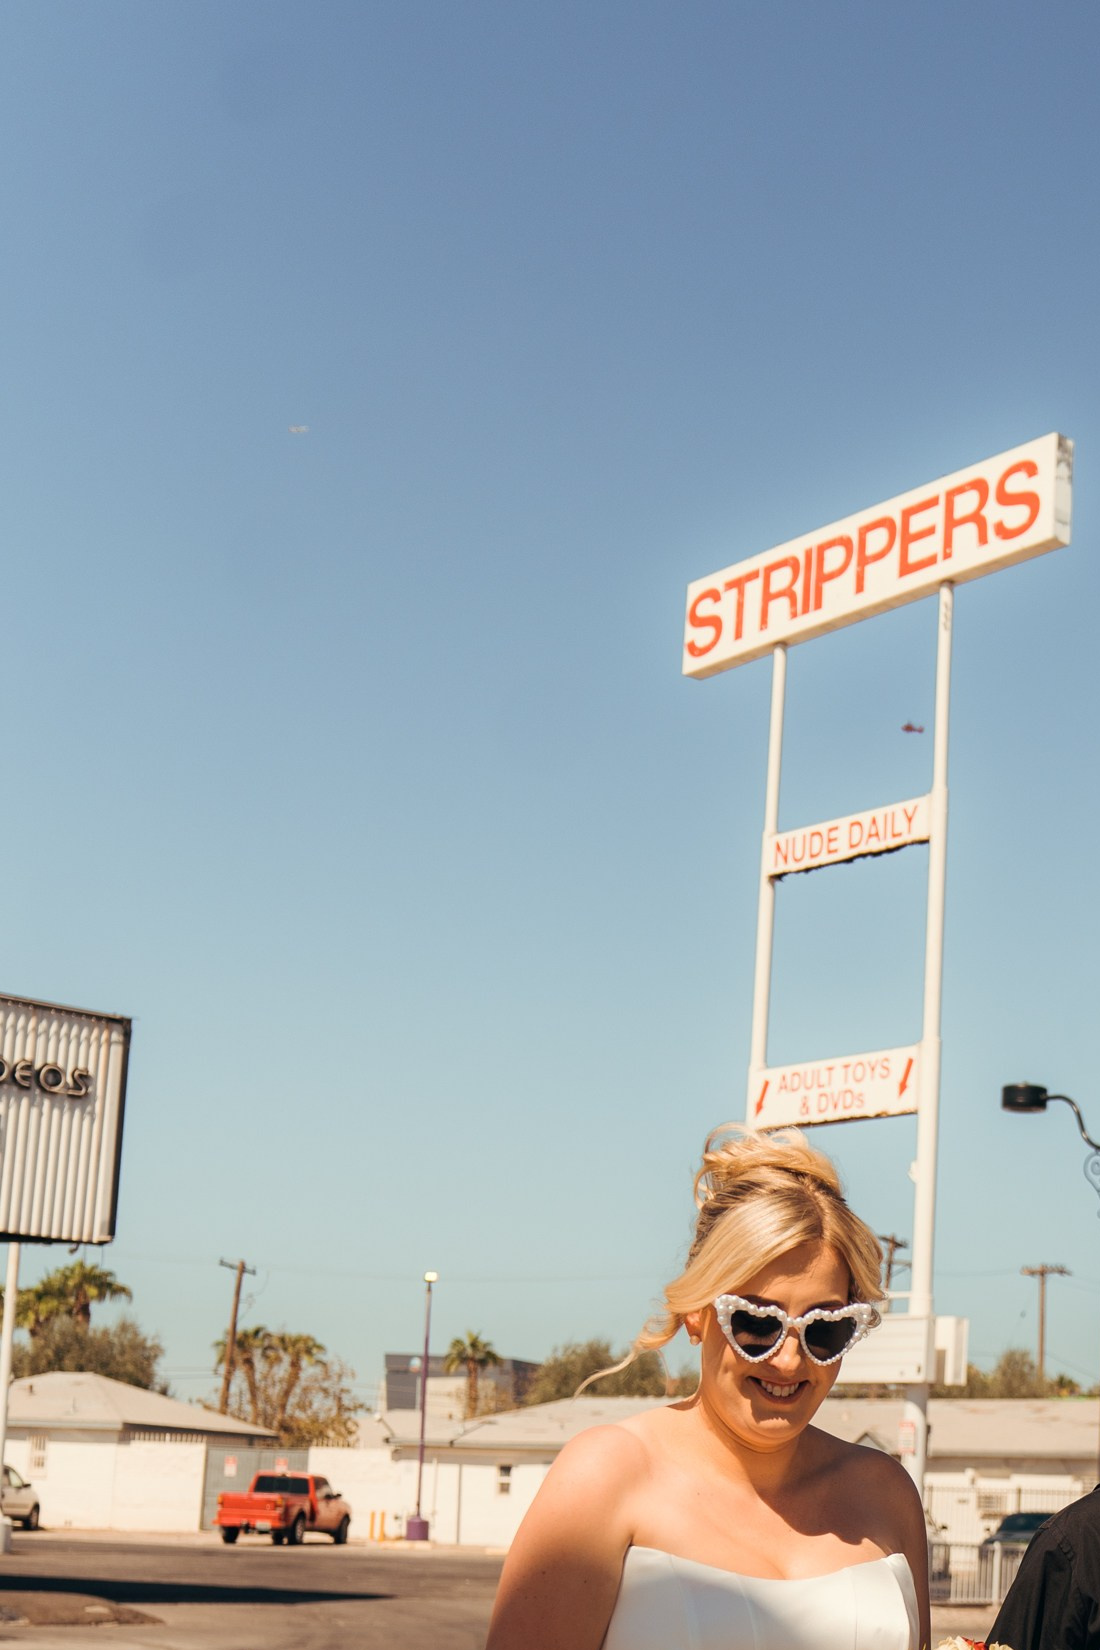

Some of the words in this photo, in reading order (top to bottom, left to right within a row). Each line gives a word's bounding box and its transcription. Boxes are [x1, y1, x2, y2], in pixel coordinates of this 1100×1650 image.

[686, 460, 1040, 658] STRIPPERS
[774, 825, 839, 868] NUDE
[849, 804, 919, 850] DAILY
[778, 1066, 835, 1094] ADULT
[842, 1057, 891, 1084] TOYS
[800, 1095, 810, 1116] &
[818, 1088, 865, 1113] DVDs
